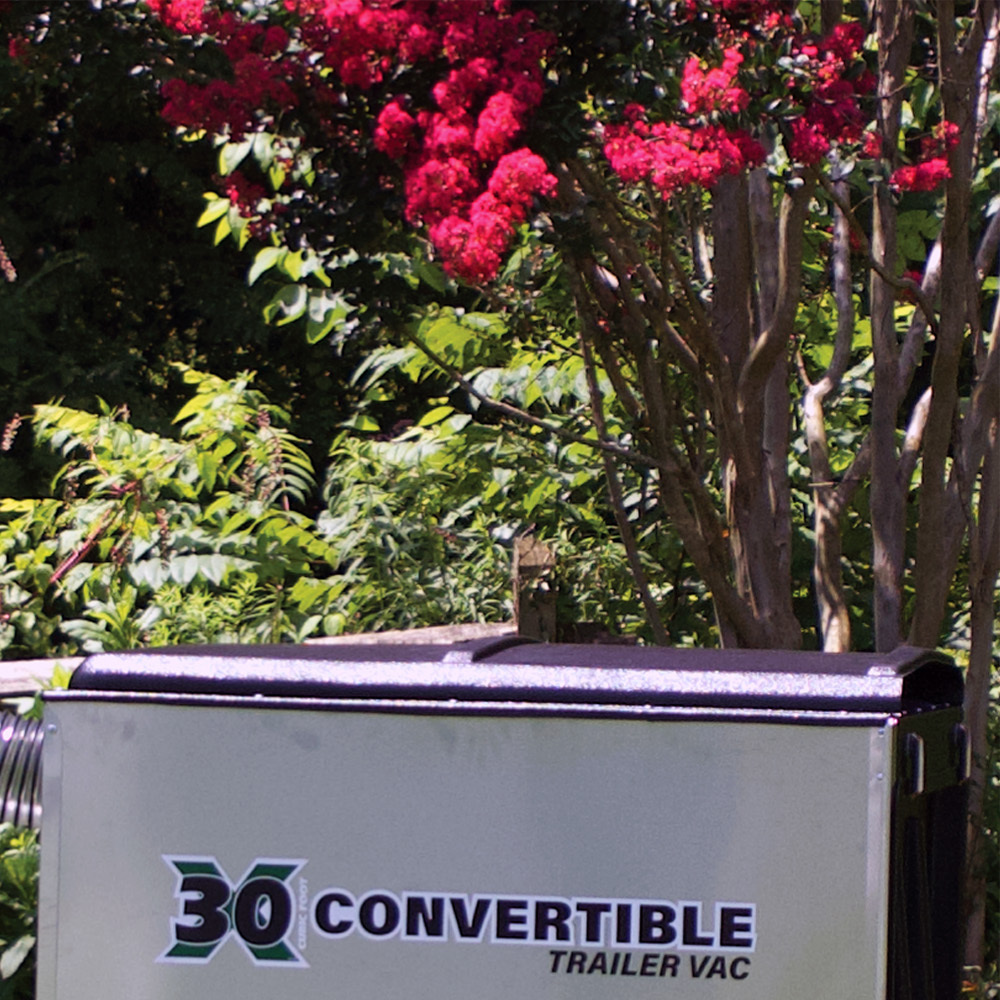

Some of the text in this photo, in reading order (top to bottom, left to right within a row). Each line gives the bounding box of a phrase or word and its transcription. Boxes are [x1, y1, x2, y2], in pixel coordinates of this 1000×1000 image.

[313, 891, 754, 949] CONVERTIBLE
[549, 950, 751, 981] TRAILER VAC
